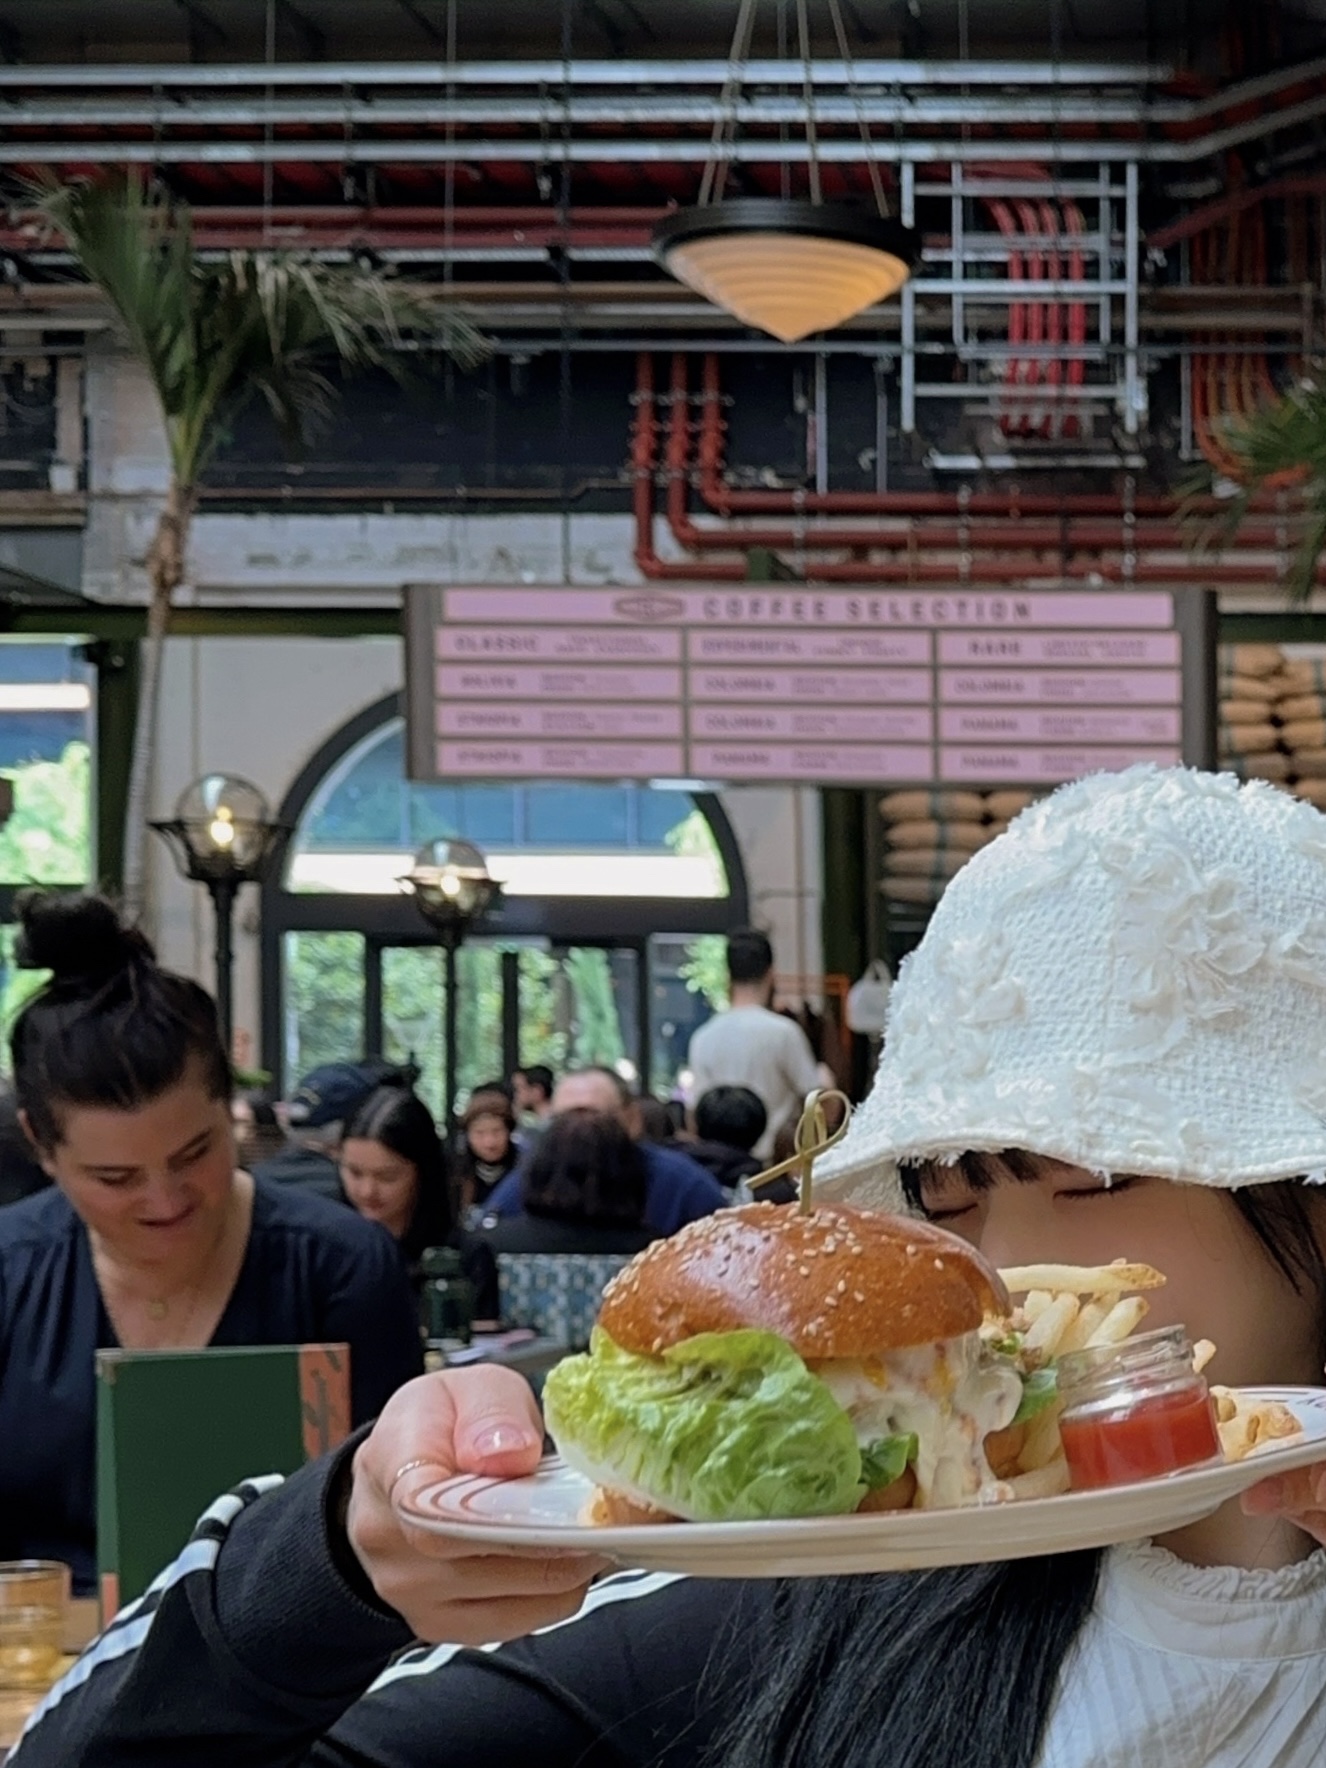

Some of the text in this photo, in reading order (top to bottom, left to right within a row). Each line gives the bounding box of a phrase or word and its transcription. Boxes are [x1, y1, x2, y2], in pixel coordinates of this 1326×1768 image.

[702, 596, 826, 621] COFFEE
[846, 597, 1030, 622] SELECTION
[454, 634, 538, 651] CLASSIC
